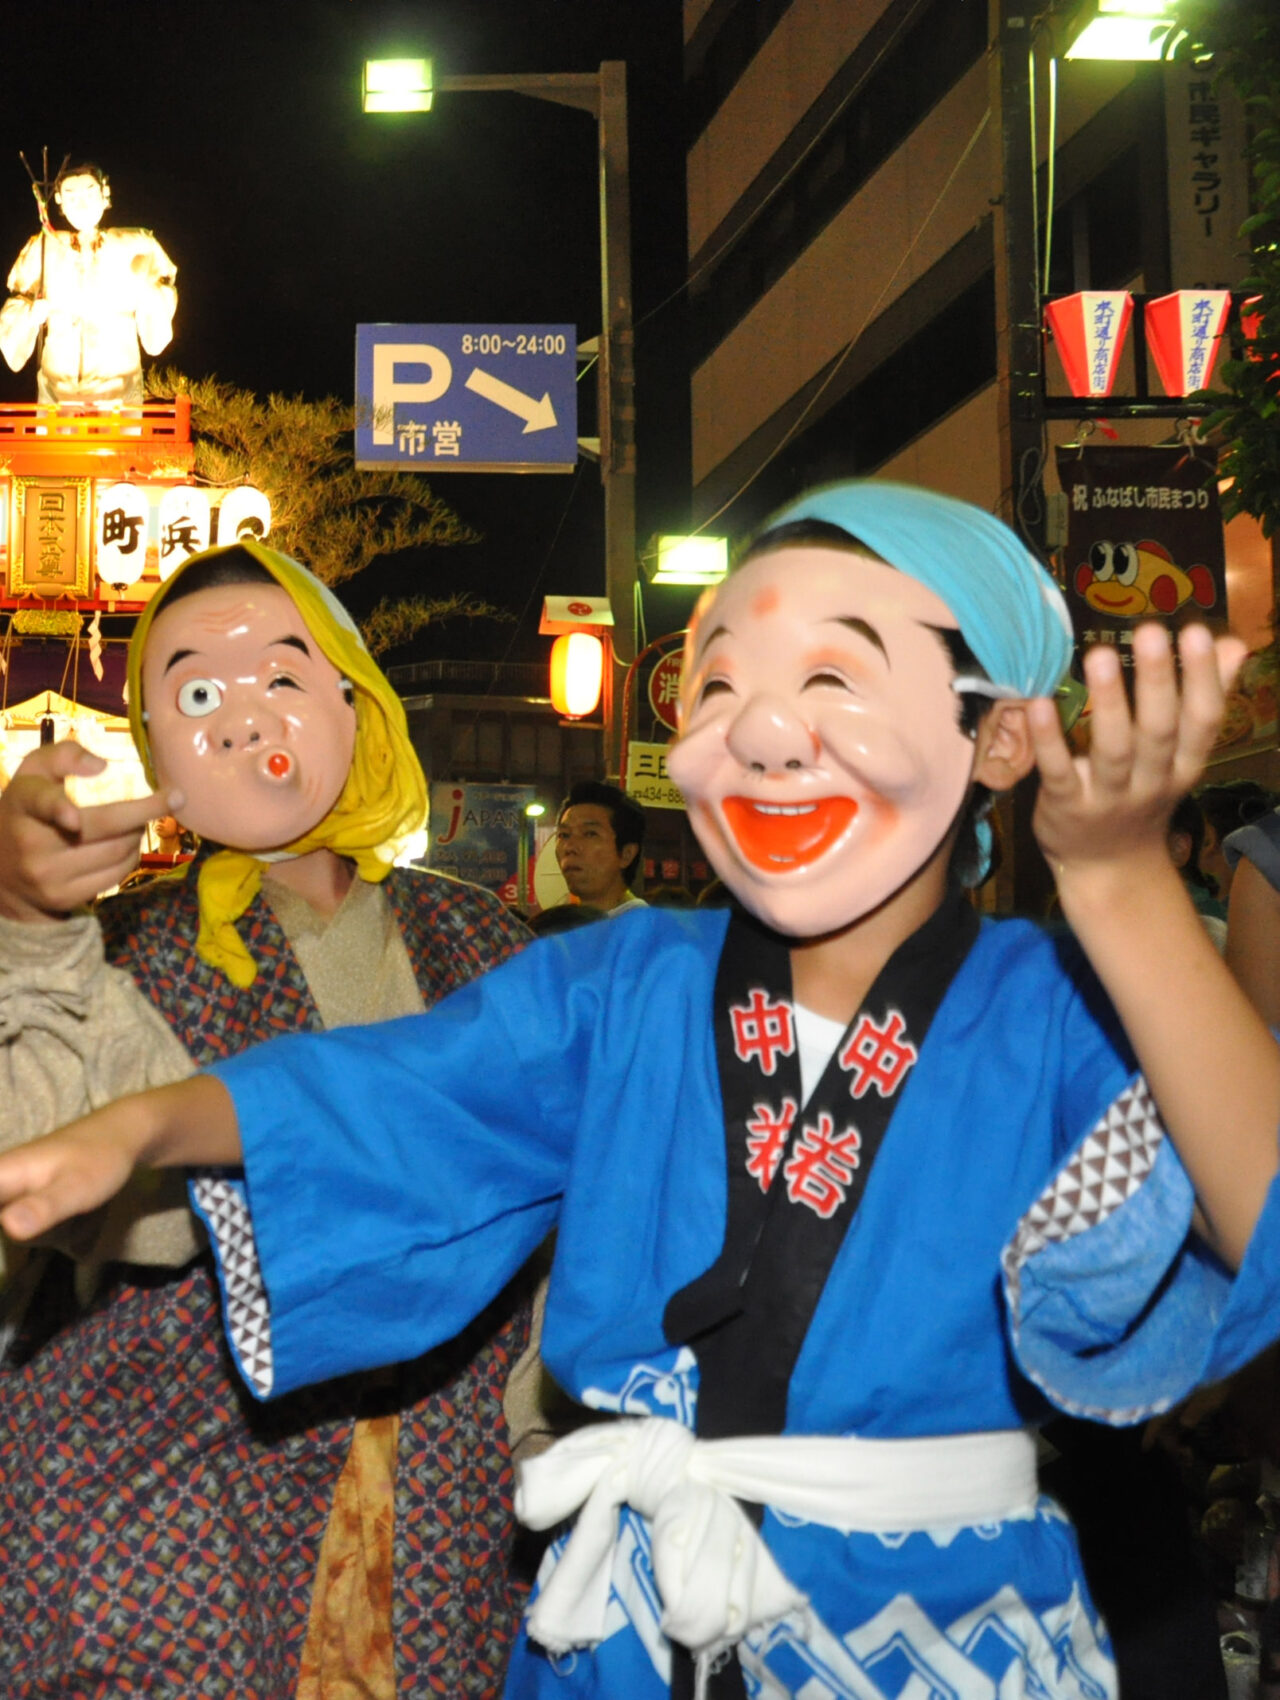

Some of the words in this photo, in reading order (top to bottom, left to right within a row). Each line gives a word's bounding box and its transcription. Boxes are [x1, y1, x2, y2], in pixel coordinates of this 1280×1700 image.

[373, 344, 452, 445] P
[397, 421, 462, 456] 市営
[1072, 484, 1088, 511] 祝
[1092, 486, 1209, 509] ふなばし市民まつり
[103, 508, 144, 554] 町
